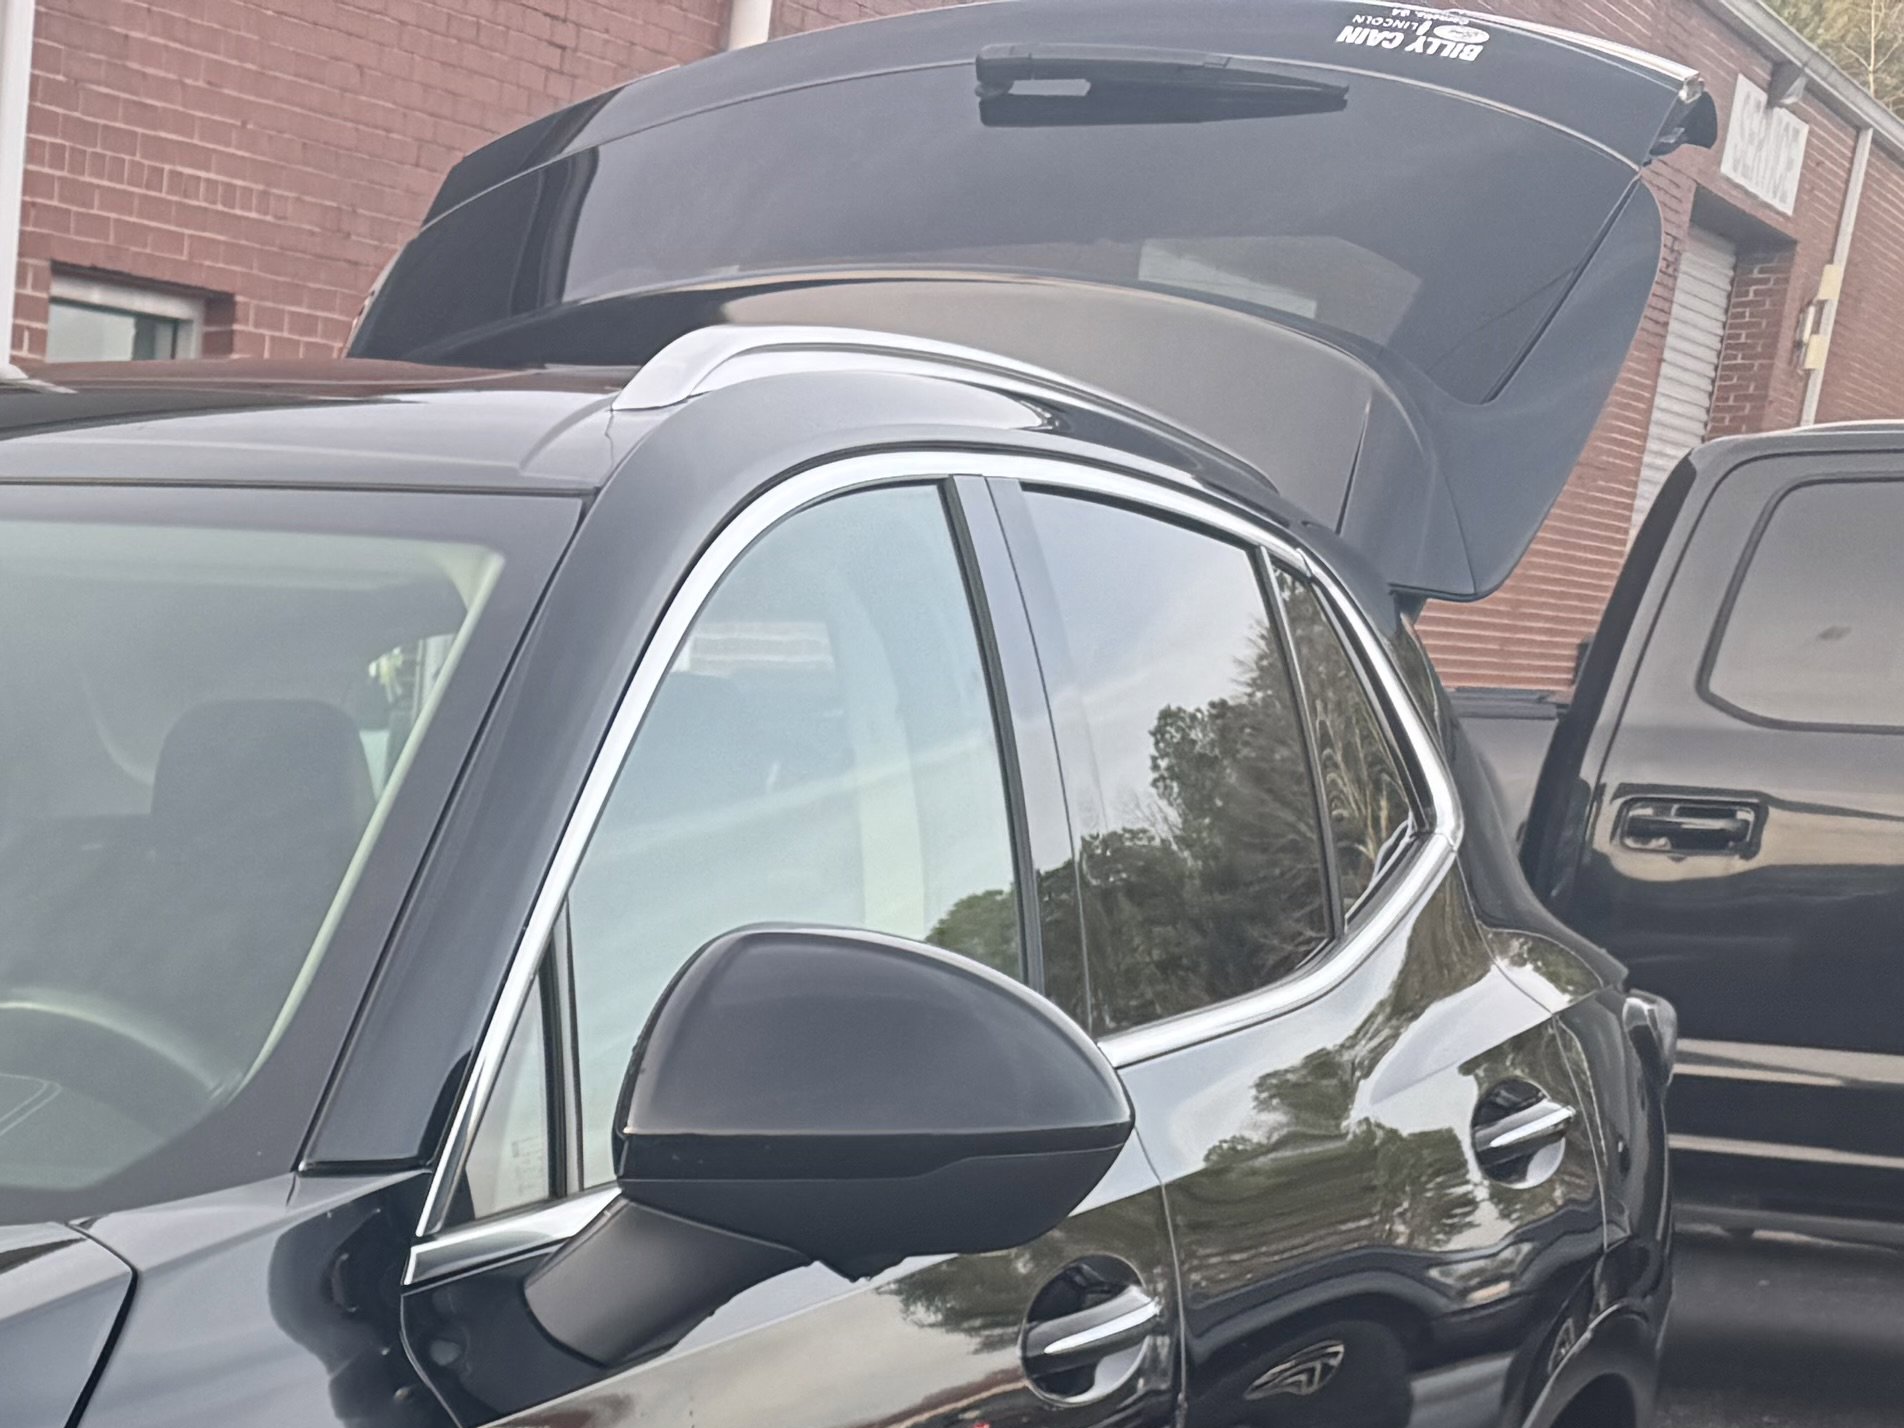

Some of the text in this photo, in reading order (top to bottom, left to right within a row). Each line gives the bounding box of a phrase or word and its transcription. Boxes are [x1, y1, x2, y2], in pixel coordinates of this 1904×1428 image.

[1352, 14, 1421, 31] LINCOLN
[1335, 25, 1484, 62] BILLY CAIN
